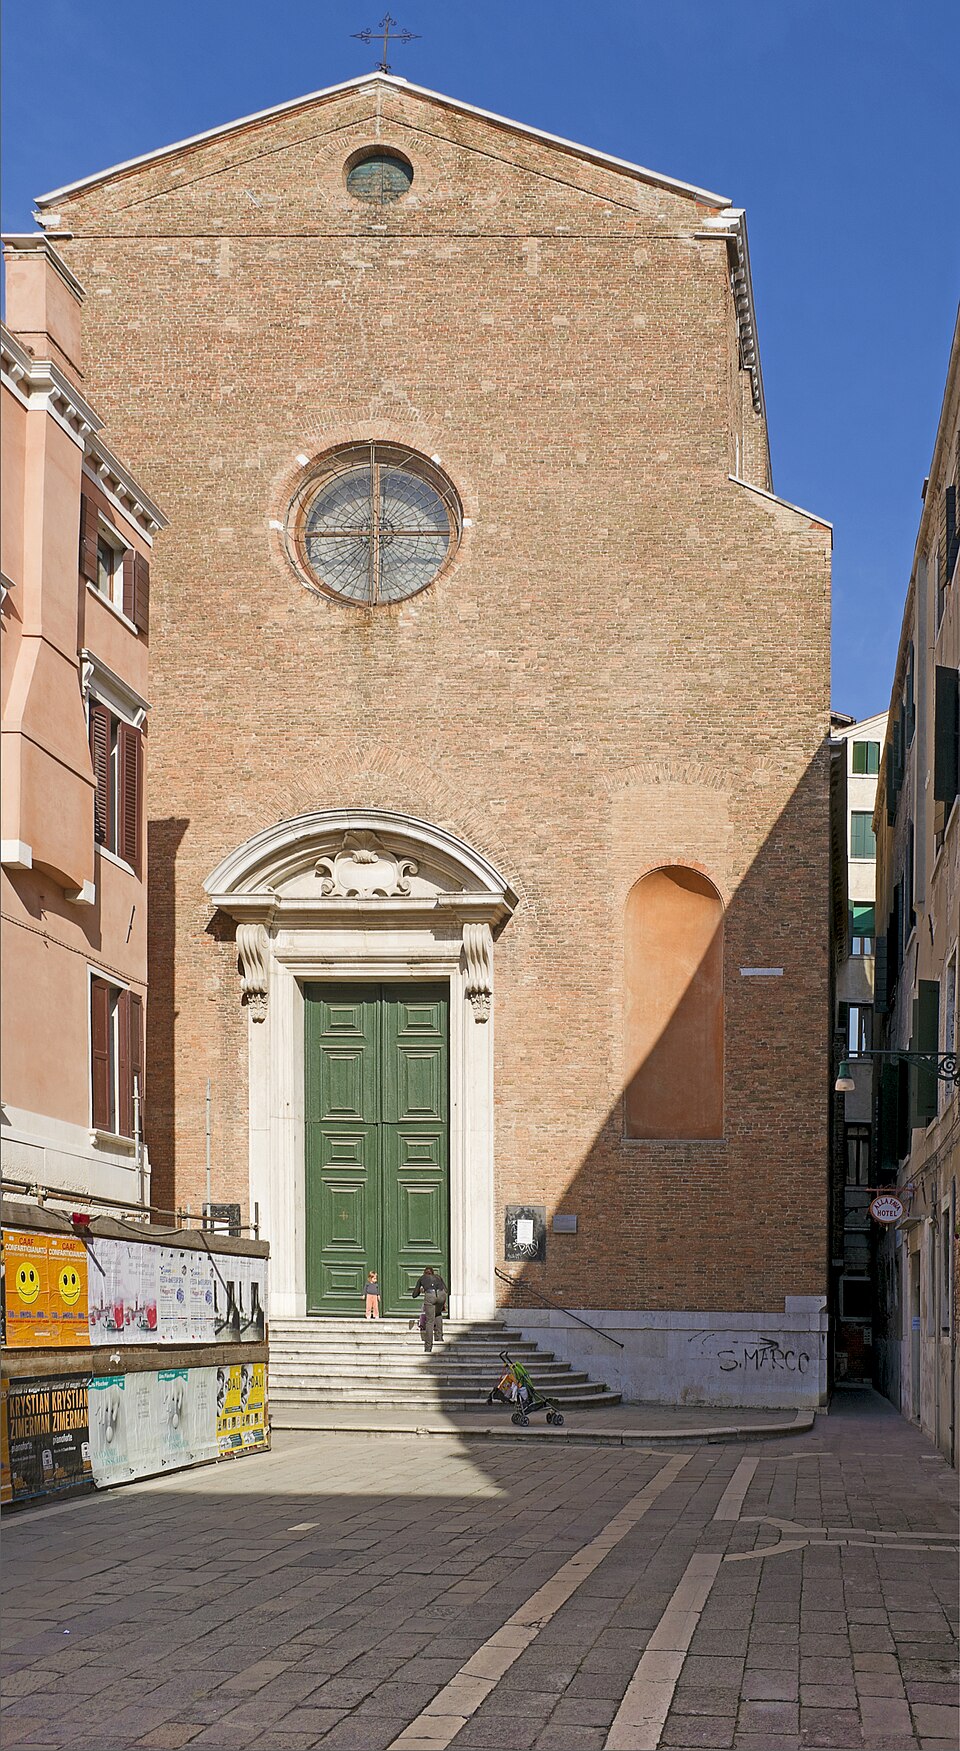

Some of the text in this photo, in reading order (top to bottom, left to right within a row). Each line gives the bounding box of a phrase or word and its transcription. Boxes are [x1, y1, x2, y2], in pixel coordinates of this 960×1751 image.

[874, 1198, 889, 1210] ALLA
[19, 1237, 34, 1246] CAAF
[61, 1242, 76, 1250] CAAF
[9, 1392, 50, 1418] KRYSTIAN
[52, 1388, 88, 1412] KRYSTIAN
[10, 1413, 50, 1440] ZIMERMAN
[52, 1408, 89, 1433] ZIMERMAN
